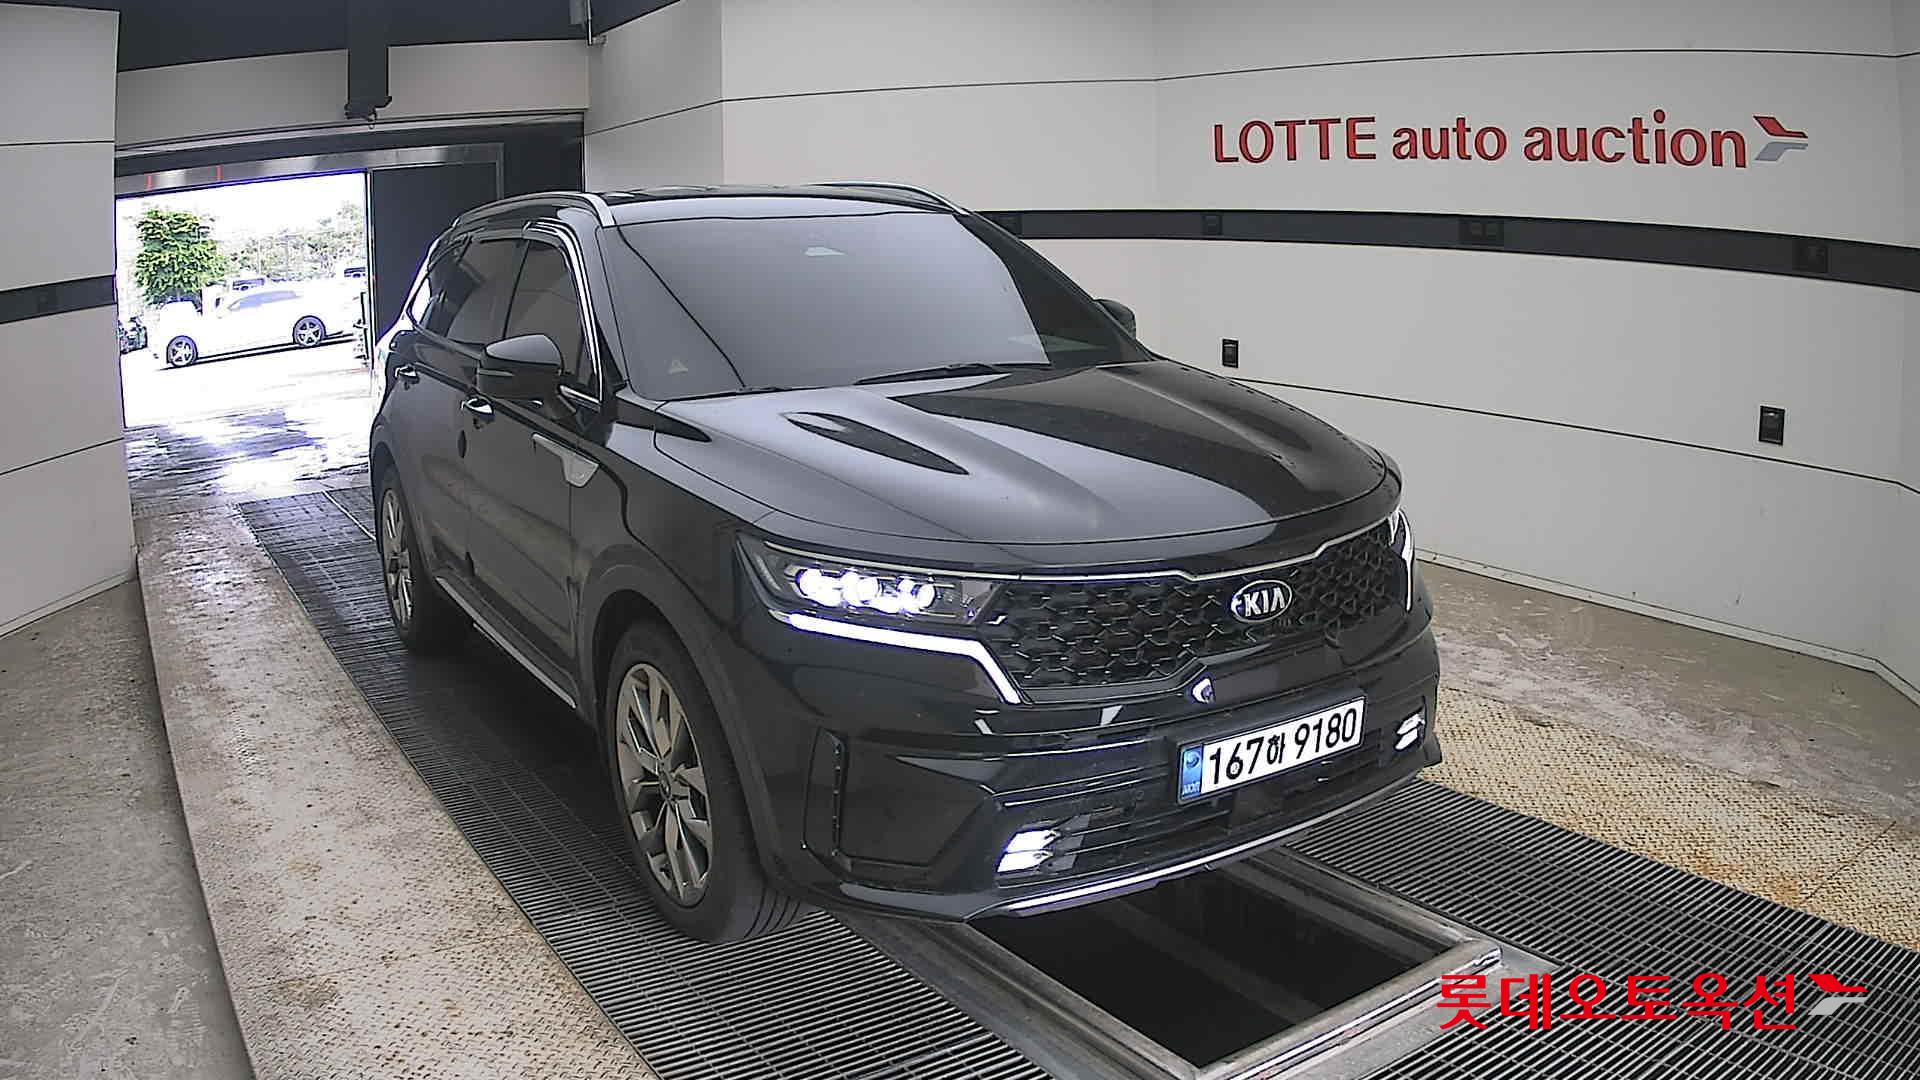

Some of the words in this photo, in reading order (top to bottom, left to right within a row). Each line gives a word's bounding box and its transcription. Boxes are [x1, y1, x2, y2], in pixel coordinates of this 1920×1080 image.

[1214, 117, 1376, 163] LOTTE
[1392, 117, 1507, 160] auto
[1523, 110, 1747, 168] auction
[1243, 587, 1285, 617] KIA
[1210, 733, 1286, 784] 167하
[1294, 708, 1356, 760] 9180
